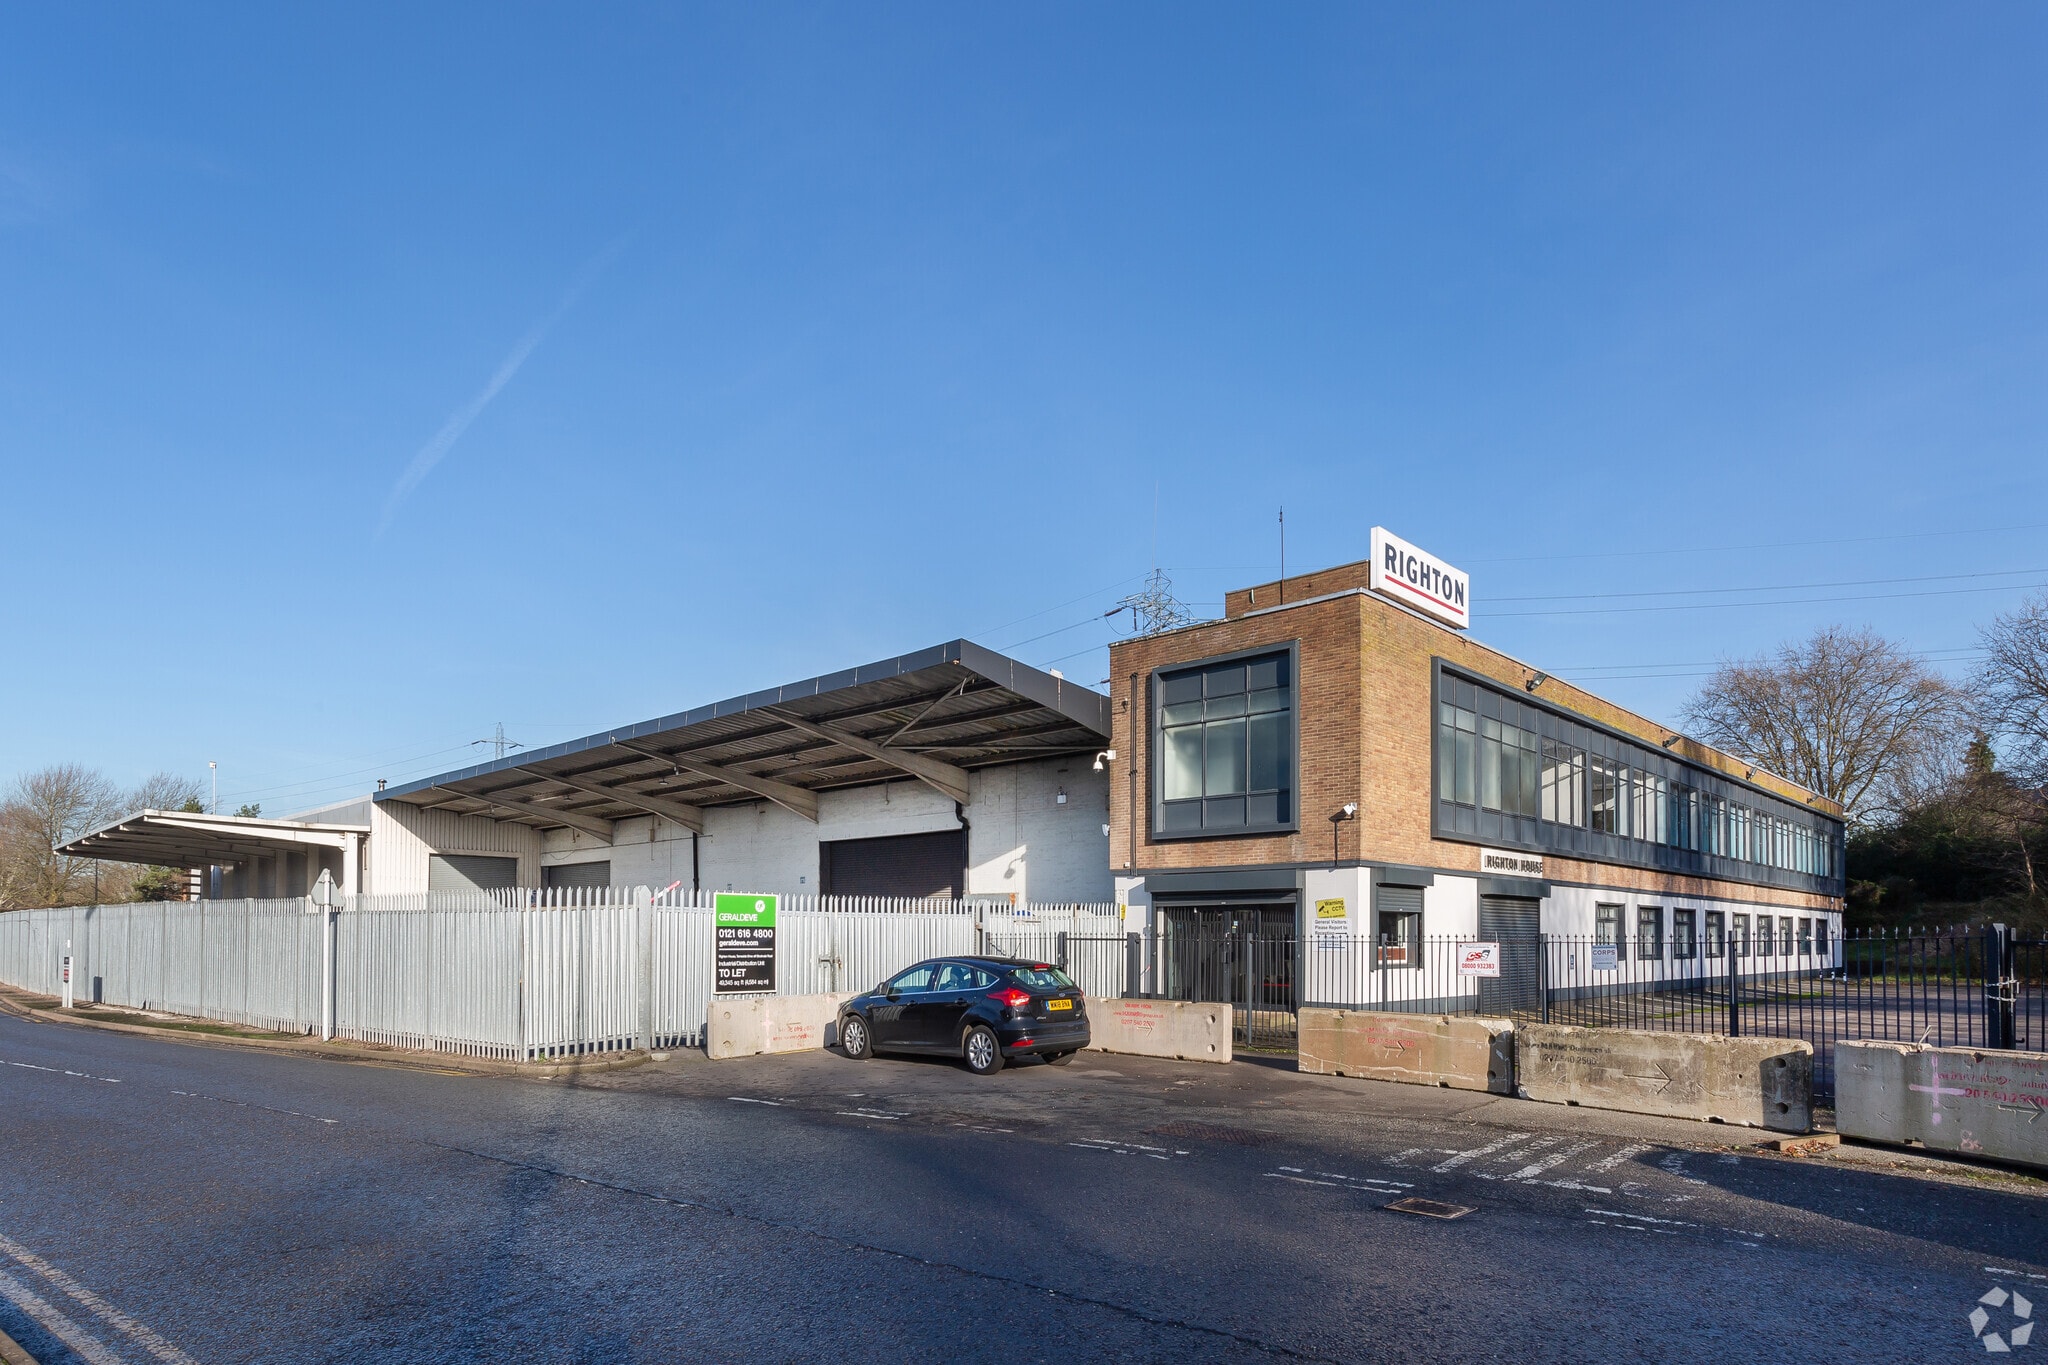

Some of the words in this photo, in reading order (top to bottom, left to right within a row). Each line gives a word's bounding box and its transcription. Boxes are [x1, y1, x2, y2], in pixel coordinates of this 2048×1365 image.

[1385, 542, 1464, 607] RIGHTON
[1485, 855, 1518, 871] RIGHTON
[1519, 859, 1543, 874] HOUSE
[719, 929, 736, 938] 0121
[738, 929, 751, 938] 616
[753, 929, 773, 938] 4800
[719, 939, 759, 948] geraldeve.com
[718, 969, 730, 978] TO
[731, 969, 746, 978] LET
